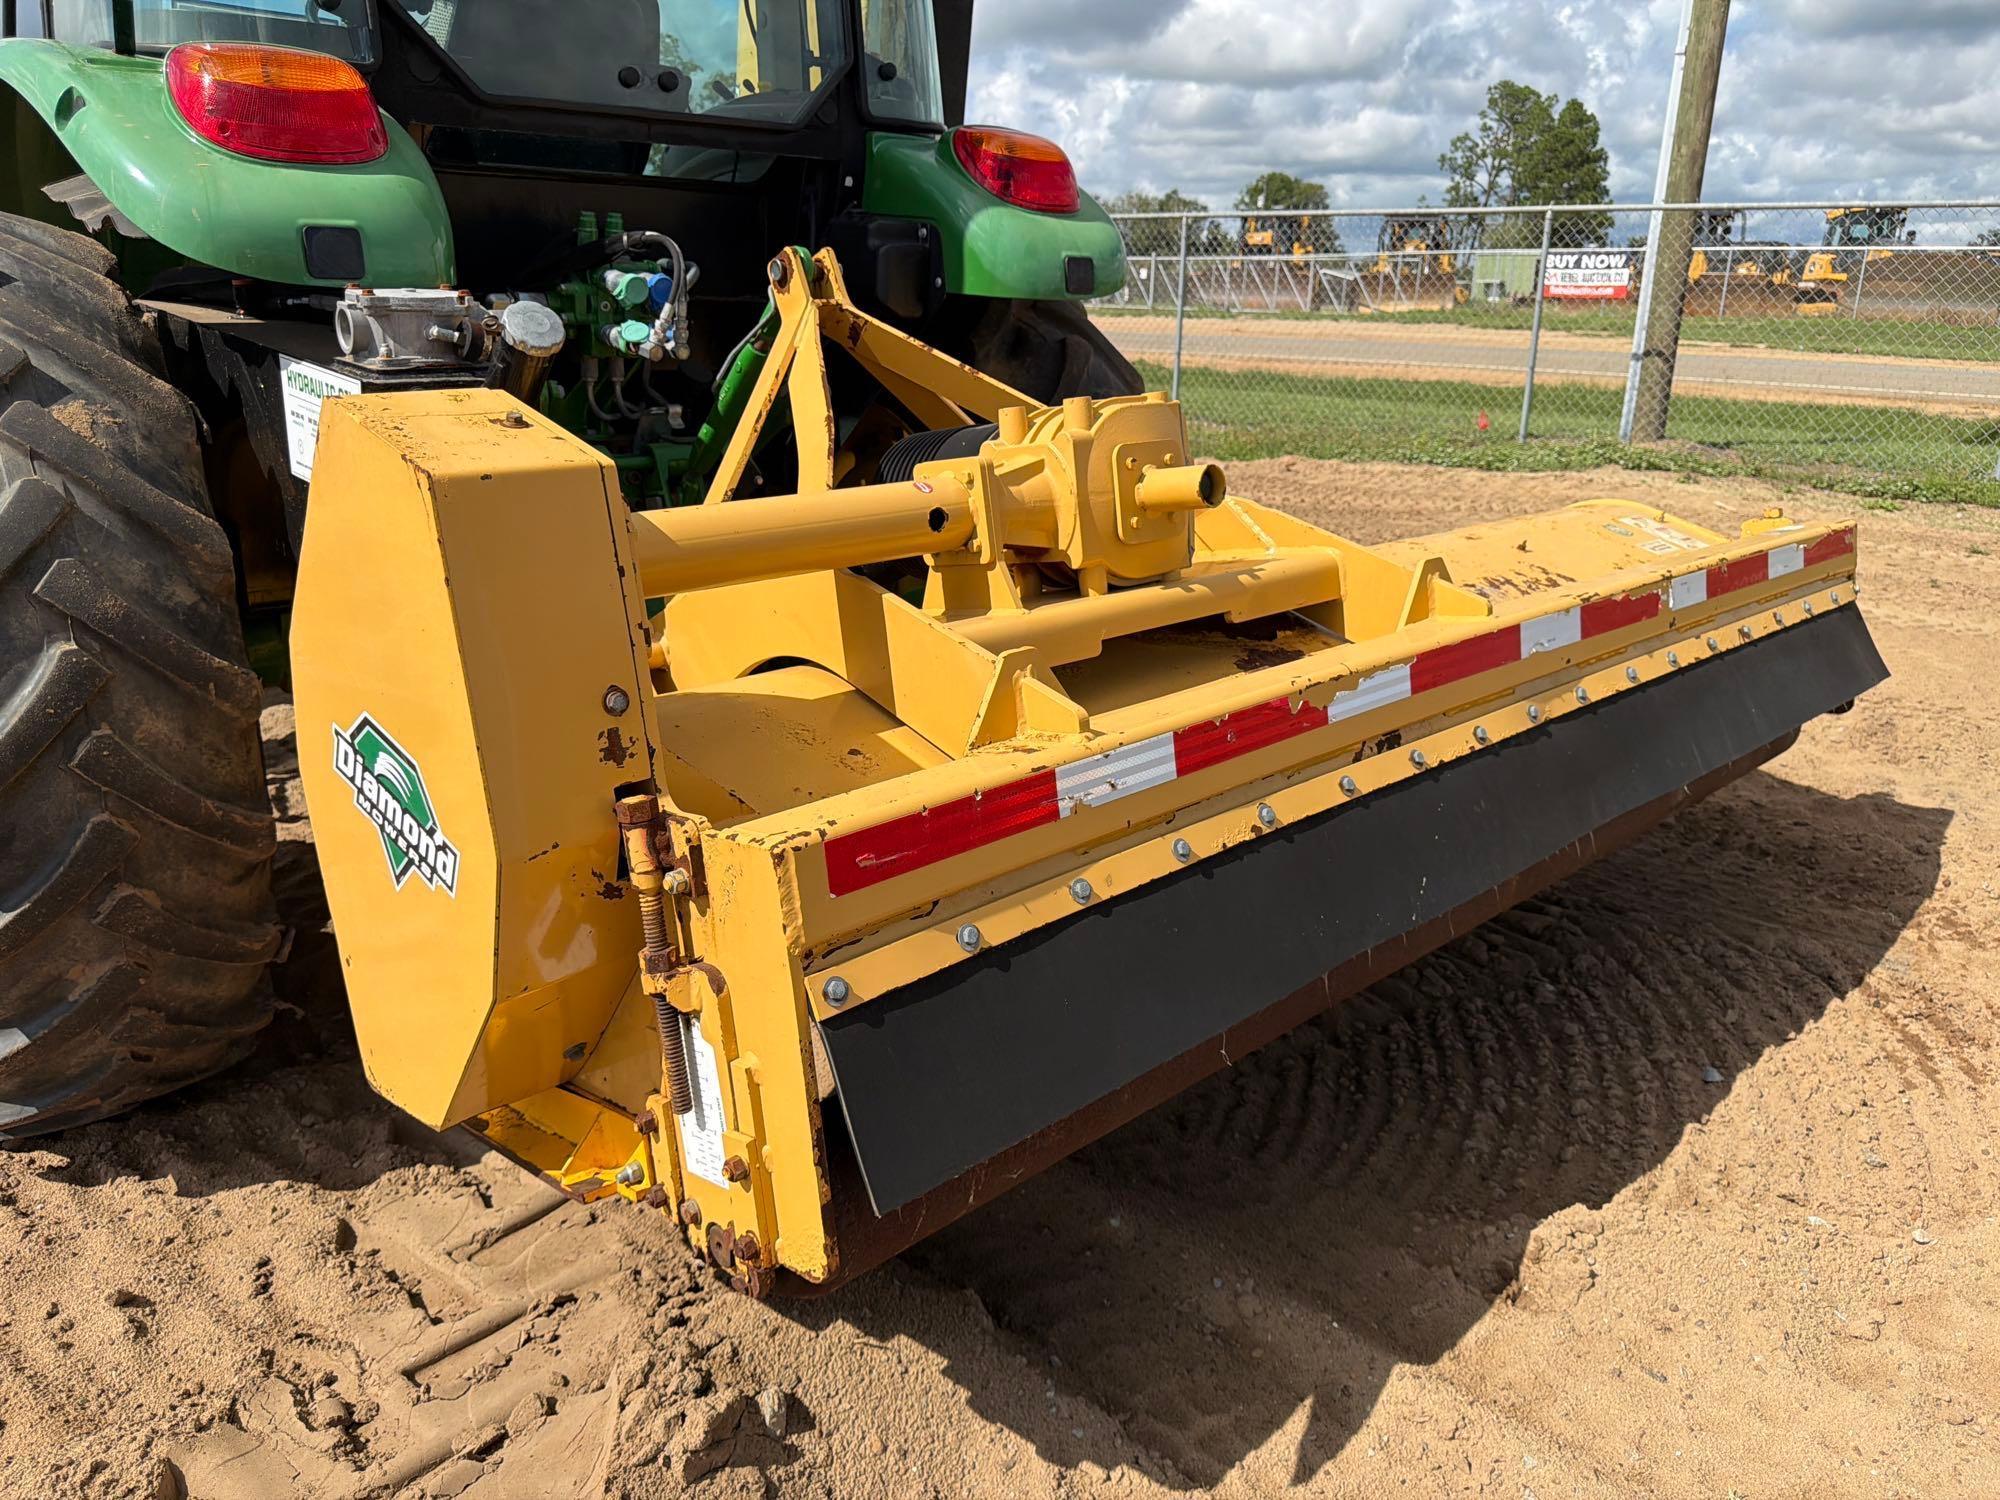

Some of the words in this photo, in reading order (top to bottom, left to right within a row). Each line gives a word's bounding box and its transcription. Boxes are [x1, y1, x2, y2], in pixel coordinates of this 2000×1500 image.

[1546, 254, 1578, 269] BUY
[1581, 254, 1627, 269] NOW
[337, 735, 455, 888] Diamond
[358, 794, 434, 879] MOWERS
